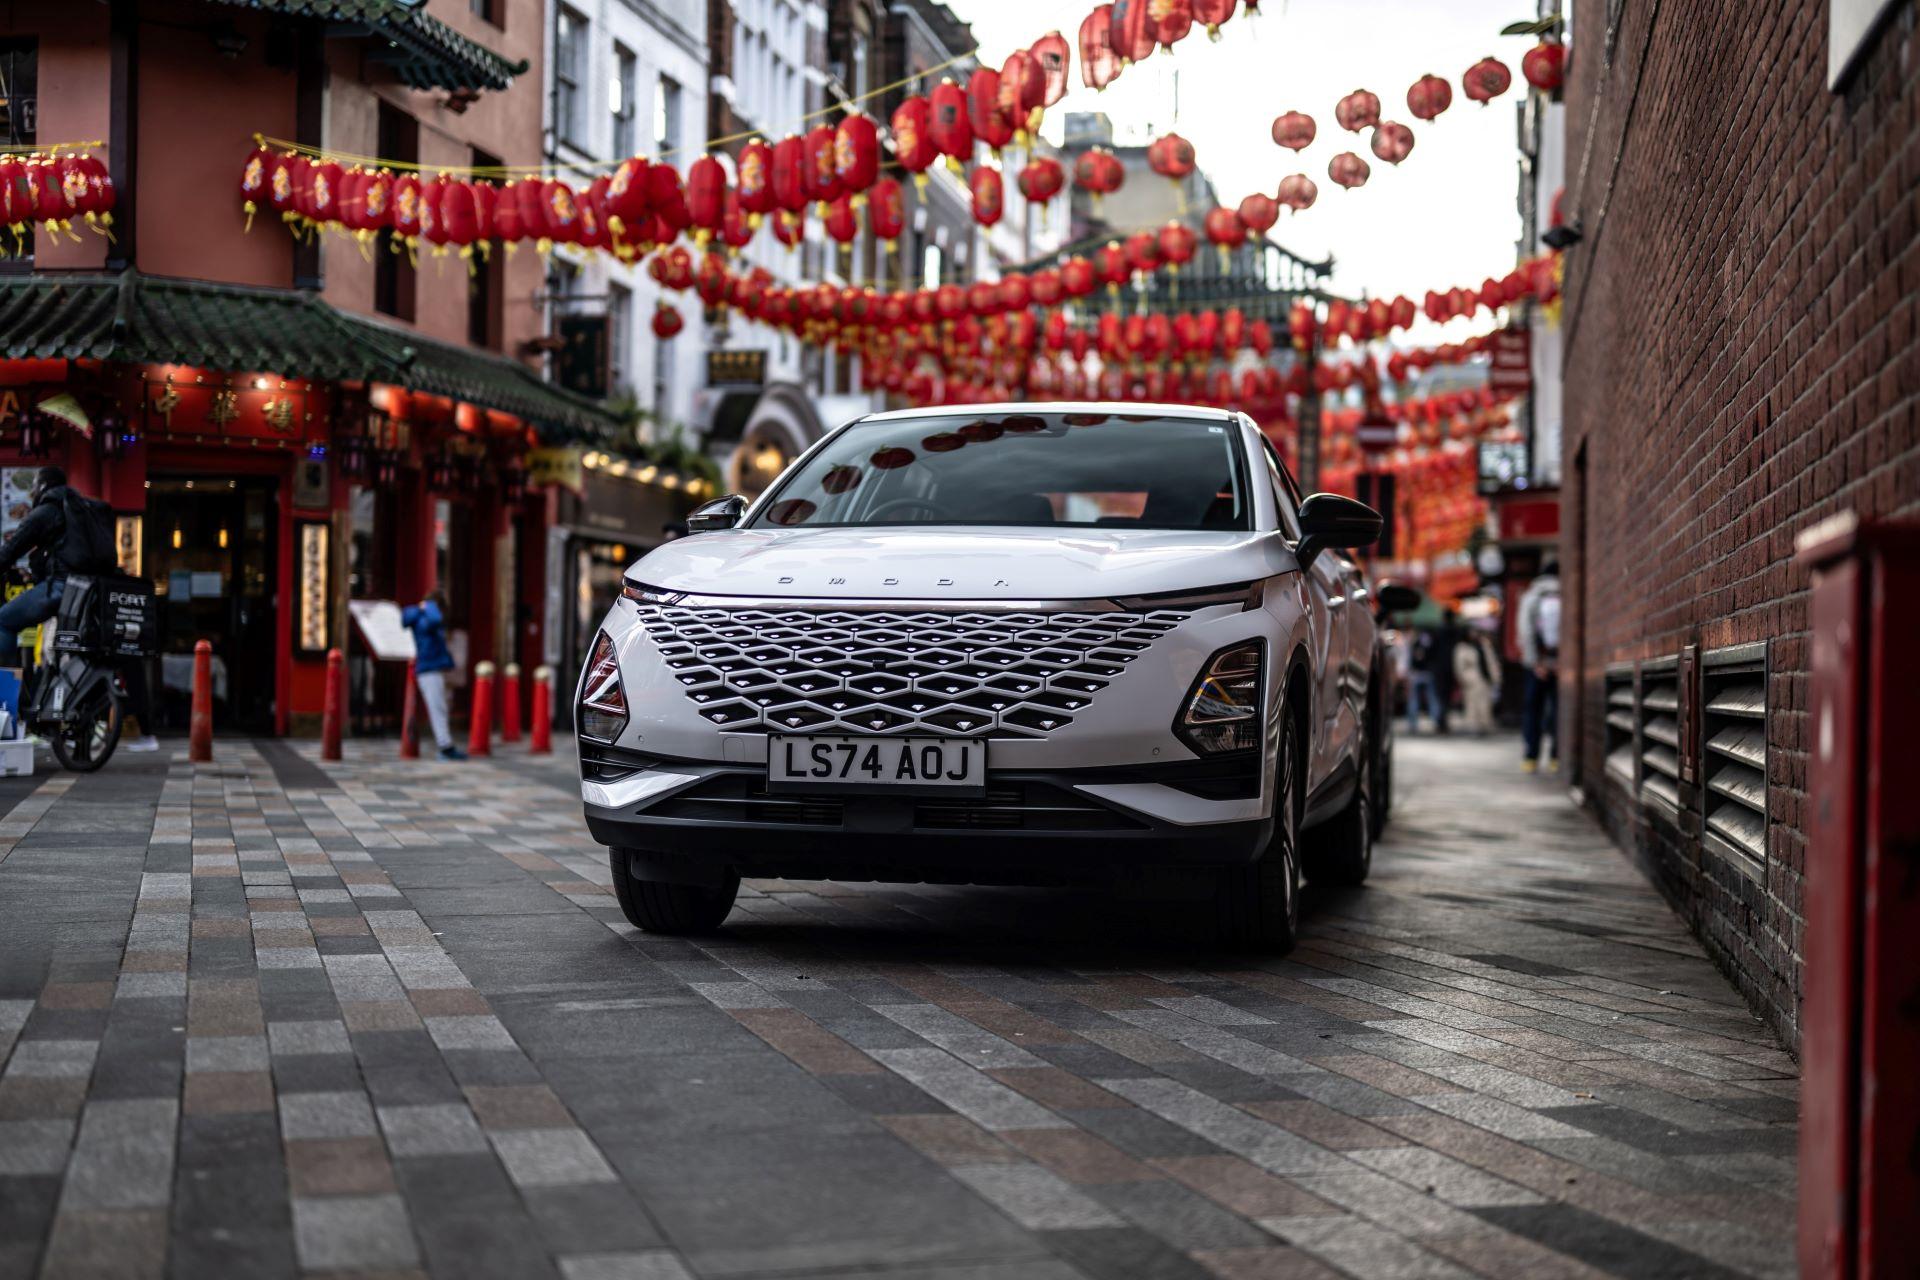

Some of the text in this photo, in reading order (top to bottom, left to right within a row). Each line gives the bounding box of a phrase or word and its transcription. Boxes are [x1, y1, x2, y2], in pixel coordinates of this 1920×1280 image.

[777, 576, 1009, 587] OMODA
[786, 743, 969, 781] LS74 AOJ
